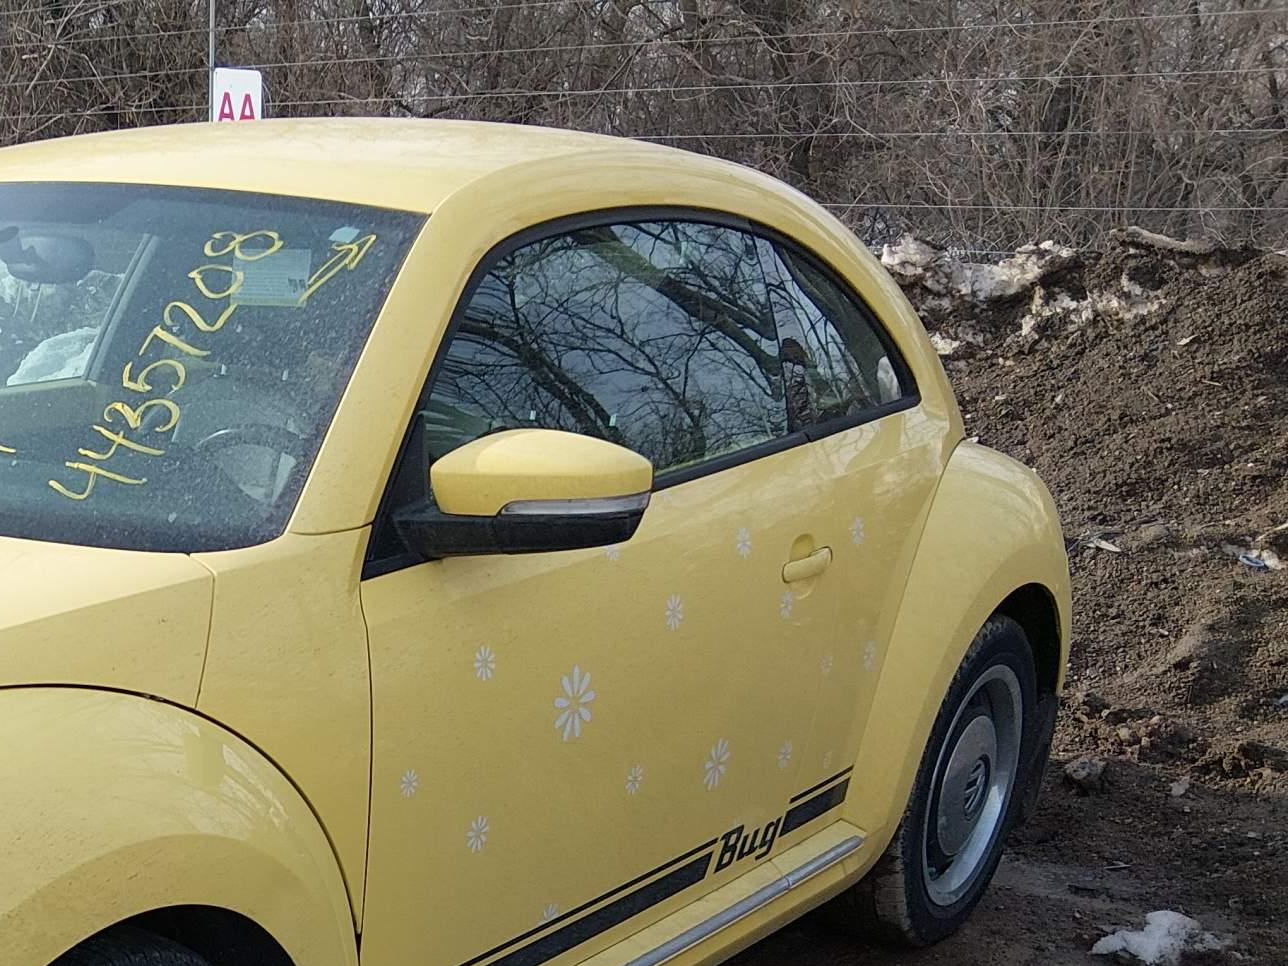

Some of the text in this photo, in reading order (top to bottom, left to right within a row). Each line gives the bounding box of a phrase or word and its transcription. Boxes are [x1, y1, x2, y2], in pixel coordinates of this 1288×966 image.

[218, 91, 256, 121] AA
[48, 230, 284, 500] 44357208
[714, 816, 783, 873] Bug
